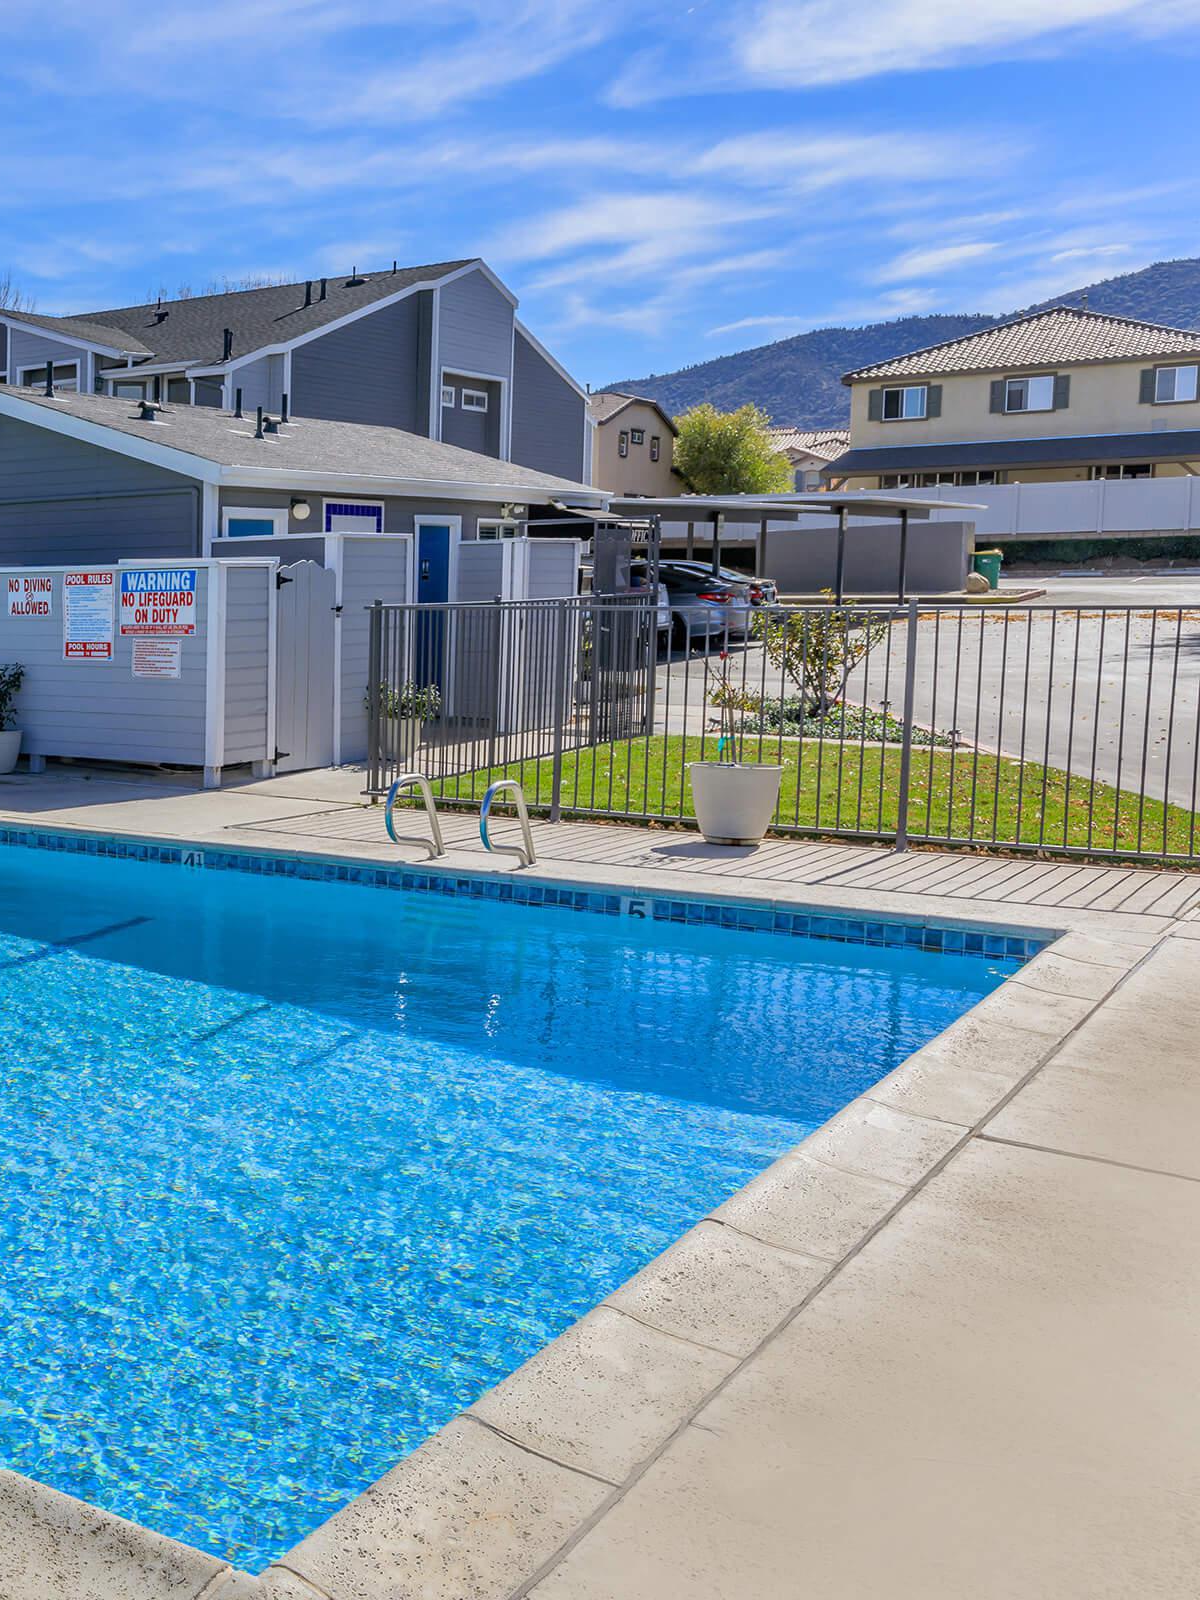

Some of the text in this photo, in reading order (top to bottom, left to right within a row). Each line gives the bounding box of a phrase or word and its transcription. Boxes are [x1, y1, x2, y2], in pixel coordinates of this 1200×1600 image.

[631, 529, 650, 542] FFIC
[8, 578, 52, 592] NO DIVING
[67, 573, 112, 585] POOL RULES
[127, 572, 191, 591] WARNING
[122, 592, 193, 607] NO LIFEGUARD
[11, 601, 49, 615] ALLOWED
[135, 608, 179, 623] ON DUTY
[68, 642, 109, 651] POOL HOURS
[628, 900, 646, 919] 5
